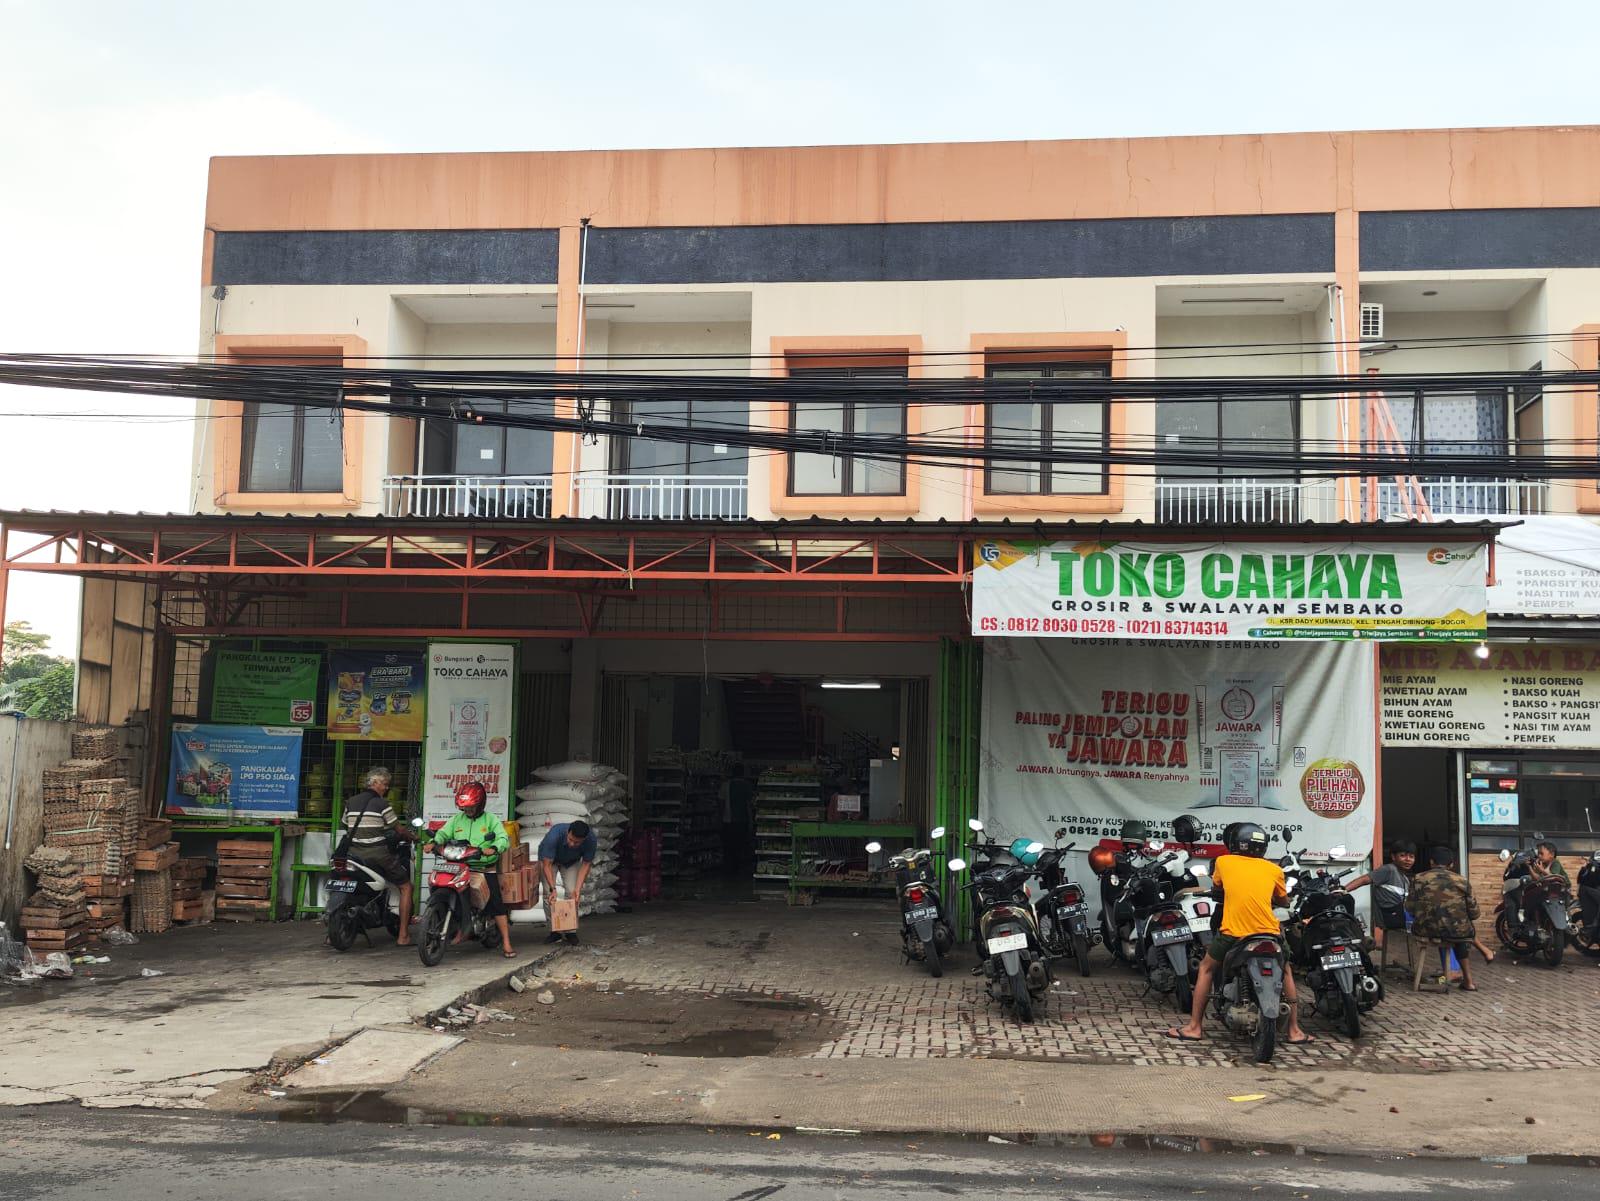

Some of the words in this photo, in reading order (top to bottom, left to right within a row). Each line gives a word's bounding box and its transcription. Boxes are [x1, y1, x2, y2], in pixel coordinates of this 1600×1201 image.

[1051, 552, 1186, 599] TOKO
[1201, 553, 1403, 599] CAHAYA
[1581, 580, 1600, 588] KU
[1557, 590, 1580, 598] TIM
[1052, 600, 1131, 612] GROSIR
[1142, 602, 1153, 612] &
[1165, 602, 1286, 615] SWALAYAN
[1297, 603, 1404, 615] SEMBAKO
[1524, 600, 1575, 608] PEMPEK
[980, 617, 998, 631] CS
[1007, 618, 1040, 632] 0812
[1043, 618, 1078, 633] 8030
[1081, 619, 1116, 633] 0528
[1127, 620, 1161, 634] (021)
[1164, 621, 1228, 636] 83714314
[1381, 647, 1440, 669] MIE
[433, 668, 463, 677] TOKO
[466, 668, 508, 677] CAHAYA
[1383, 676, 1403, 684] MIE
[1406, 676, 1436, 684] AYAM
[1511, 677, 1536, 685] NASI
[1539, 677, 1584, 686] GORENG
[1383, 687, 1434, 695] KWETIAU
[1437, 687, 1468, 695] AYAM
[1512, 689, 1548, 697] BAKSO
[1551, 689, 1581, 697] KUAH
[1102, 690, 1190, 716] TERIGU
[1384, 698, 1419, 706] BIHUN
[1422, 699, 1452, 707] AYAM
[1512, 700, 1548, 708] BAKSO
[1384, 710, 1404, 718] MIE
[1407, 710, 1454, 718] GORENG
[1513, 711, 1558, 720] PANGSIT
[1560, 712, 1590, 720] KUAH
[1015, 711, 1061, 727] PALING
[1215, 722, 1262, 733] JAWARA
[1384, 721, 1435, 729] KWETIAU
[1438, 722, 1486, 730] GORENG
[1513, 723, 1537, 731] NASI
[1540, 723, 1560, 732] TIM
[1563, 724, 1592, 732] AYAM
[1385, 733, 1420, 741] BIHUN
[1424, 733, 1470, 741] GORENG
[1513, 735, 1556, 743] PEMPEK
[1048, 733, 1067, 749] YA
[1067, 735, 1188, 768] JAWARA
[240, 765, 287, 773] PANGKALAN
[1016, 764, 1054, 774] JAWARA
[1056, 766, 1102, 778] Untungnya,
[1104, 770, 1142, 780] JAWARA
[1143, 772, 1190, 782] Renyahnya
[1312, 769, 1352, 778] TERIGU
[272, 773, 296, 781] SIAGA
[1306, 778, 1358, 792] PILIHAN
[1306, 792, 1358, 801] KUALITAS
[1312, 801, 1353, 811] JEPANG
[1046, 815, 1059, 823] JL.
[1061, 815, 1078, 824] KSR
[1079, 816, 1103, 825] DADY
[1069, 826, 1099, 836] 0812
[1320, 956, 1325, 964] F
